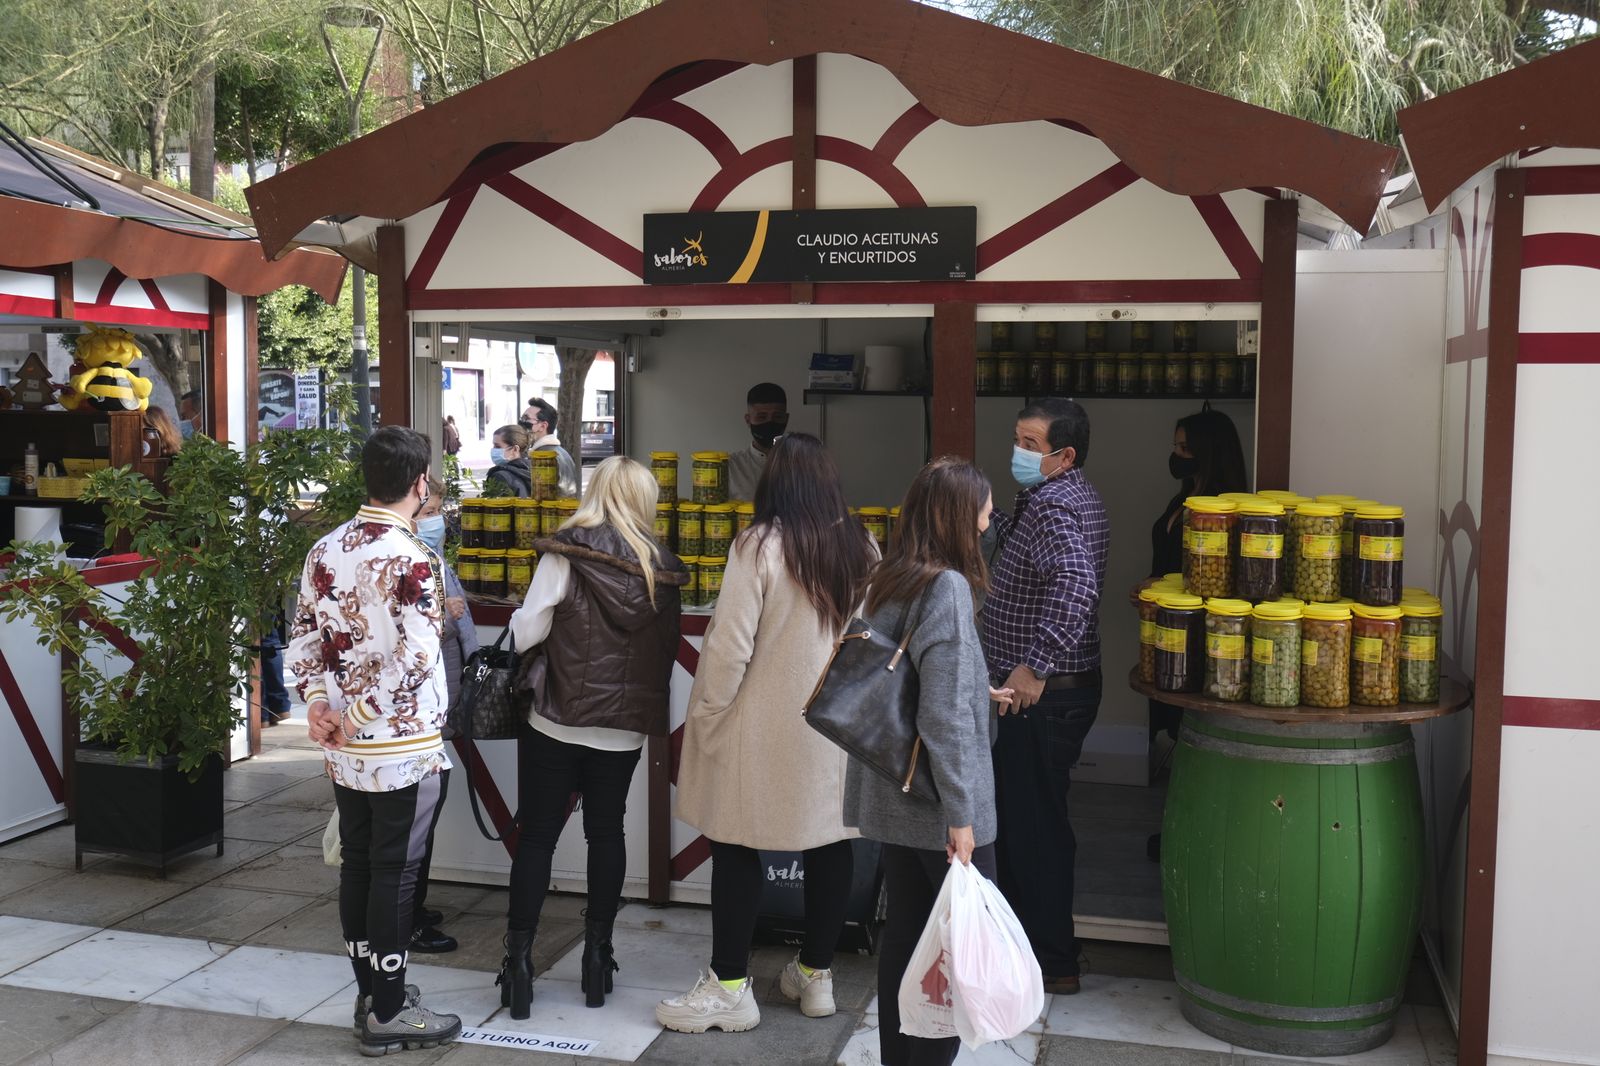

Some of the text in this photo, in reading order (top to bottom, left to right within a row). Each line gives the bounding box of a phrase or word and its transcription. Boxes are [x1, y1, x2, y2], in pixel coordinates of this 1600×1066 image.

[797, 232, 939, 246] CLAUDIO ACEITUNAS
[653, 247, 708, 267] sabores
[818, 251, 917, 264] Y ENCURTIDOS
[480, 1033, 540, 1046] TURNO
[542, 1041, 590, 1051] AQUÍ
